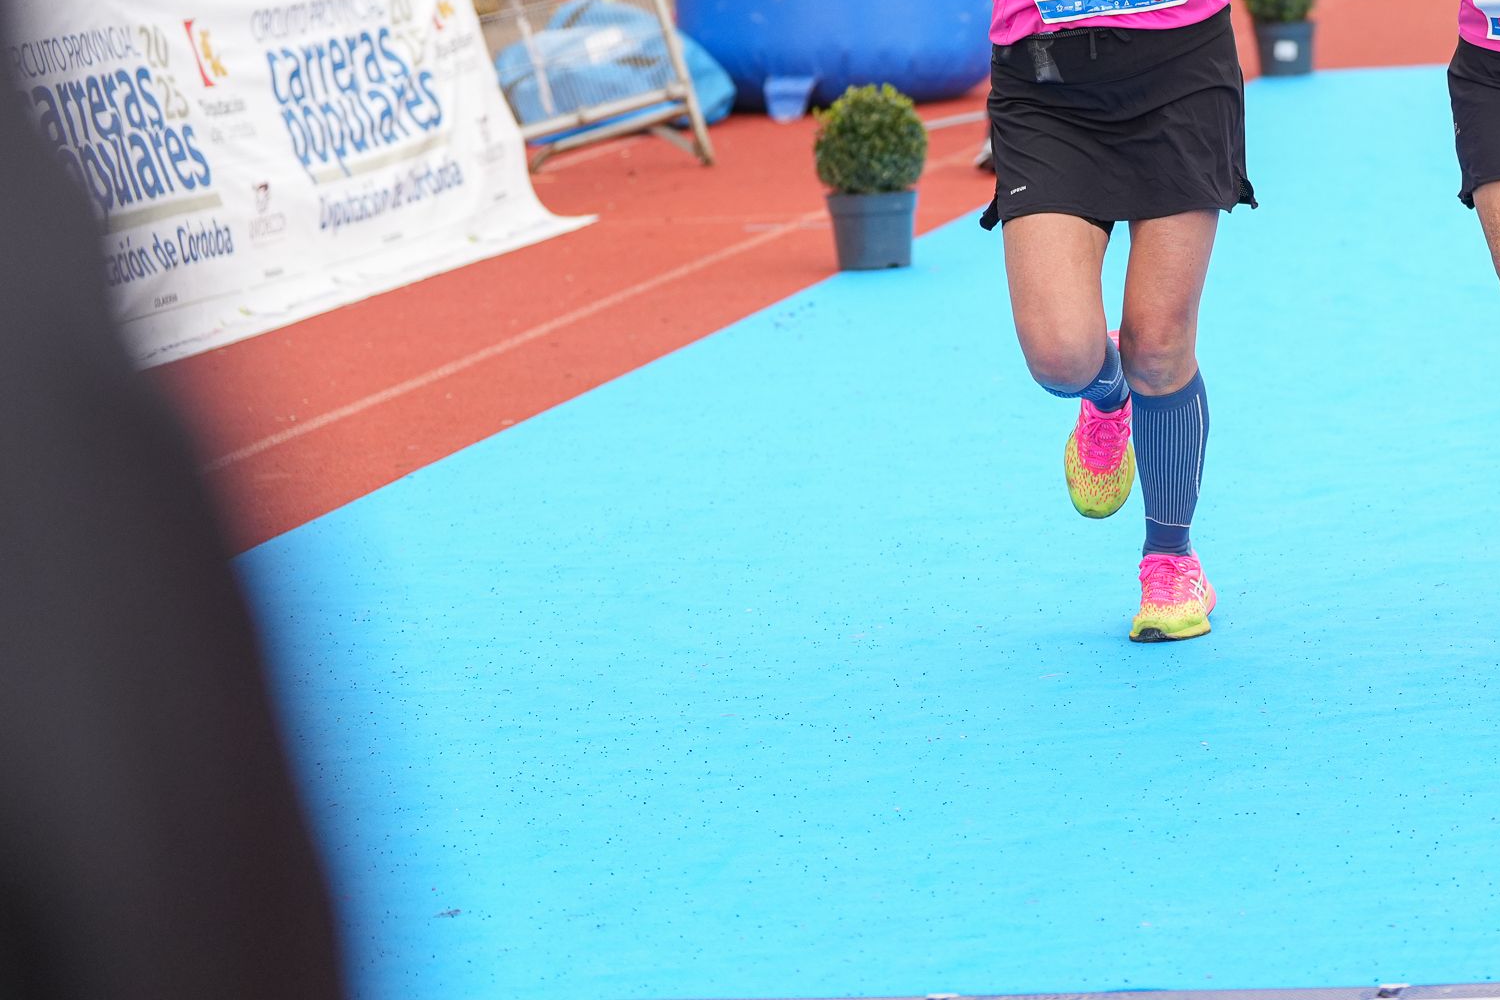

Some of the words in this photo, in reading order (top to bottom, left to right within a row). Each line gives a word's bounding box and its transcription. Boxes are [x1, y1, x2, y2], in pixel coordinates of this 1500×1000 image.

[266, 26, 411, 105] carreras
[60, 123, 212, 218] pulares
[281, 70, 442, 186] populares
[152, 232, 178, 273] de
[176, 215, 235, 268] Córdoba
